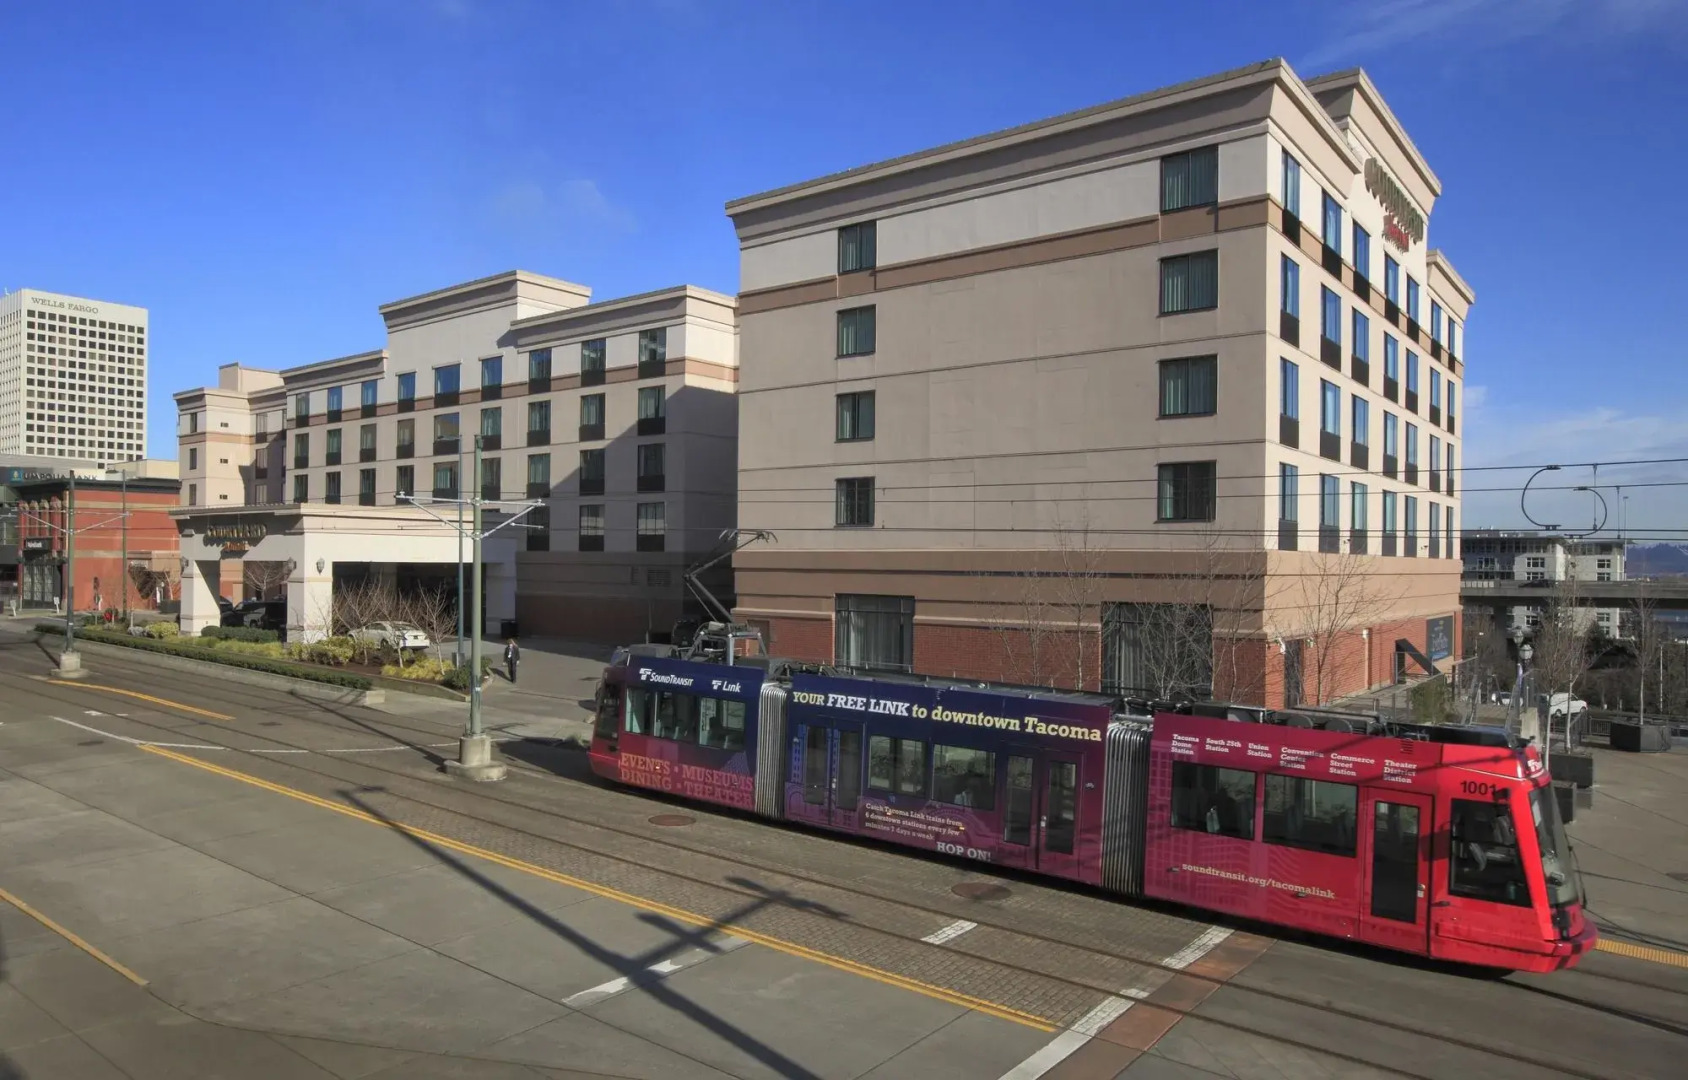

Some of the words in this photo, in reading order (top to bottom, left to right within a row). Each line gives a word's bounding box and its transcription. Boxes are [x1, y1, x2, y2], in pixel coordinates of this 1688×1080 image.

[32, 297, 64, 308] WELLS
[68, 303, 98, 314] FARGO
[722, 681, 741, 692] Link
[793, 691, 825, 706] YOUR
[827, 693, 867, 711] FREE
[868, 699, 910, 716] LINK
[912, 704, 928, 718] to
[932, 706, 1020, 731] downtown
[1024, 716, 1102, 742] Tacoma
[1173, 734, 1199, 742] Tacoma
[1206, 738, 1225, 746] South
[1172, 740, 1192, 748] Dome
[1205, 745, 1229, 753] Station
[1248, 743, 1269, 751] Union
[1171, 746, 1194, 755] Station
[1247, 750, 1272, 758] Station
[1281, 747, 1324, 758] Convention
[1330, 753, 1375, 765] Commerce
[1330, 760, 1353, 768] Street
[1384, 759, 1417, 769] Theater
[1280, 760, 1305, 770] Station
[621, 752, 670, 774] EVENTS
[682, 764, 753, 791] MUSEUMS
[1329, 767, 1356, 776] Station
[1384, 766, 1416, 776] District
[1383, 774, 1412, 784] Station
[621, 769, 672, 790] DINING
[684, 780, 752, 808] THEATER
[866, 803, 883, 811] Catch
[910, 811, 925, 820] Link
[926, 815, 945, 823] trains
[946, 817, 962, 826] from
[865, 822, 892, 831] minutes
[896, 826, 910, 836] days
[870, 813, 900, 824] downtown
[902, 819, 926, 829] stations
[928, 824, 946, 835] every
[948, 828, 960, 836] few
[936, 841, 964, 856] HOP
[967, 848, 992, 862] ON!
[1182, 863, 1335, 899] soundtransit.org/tacomalink
